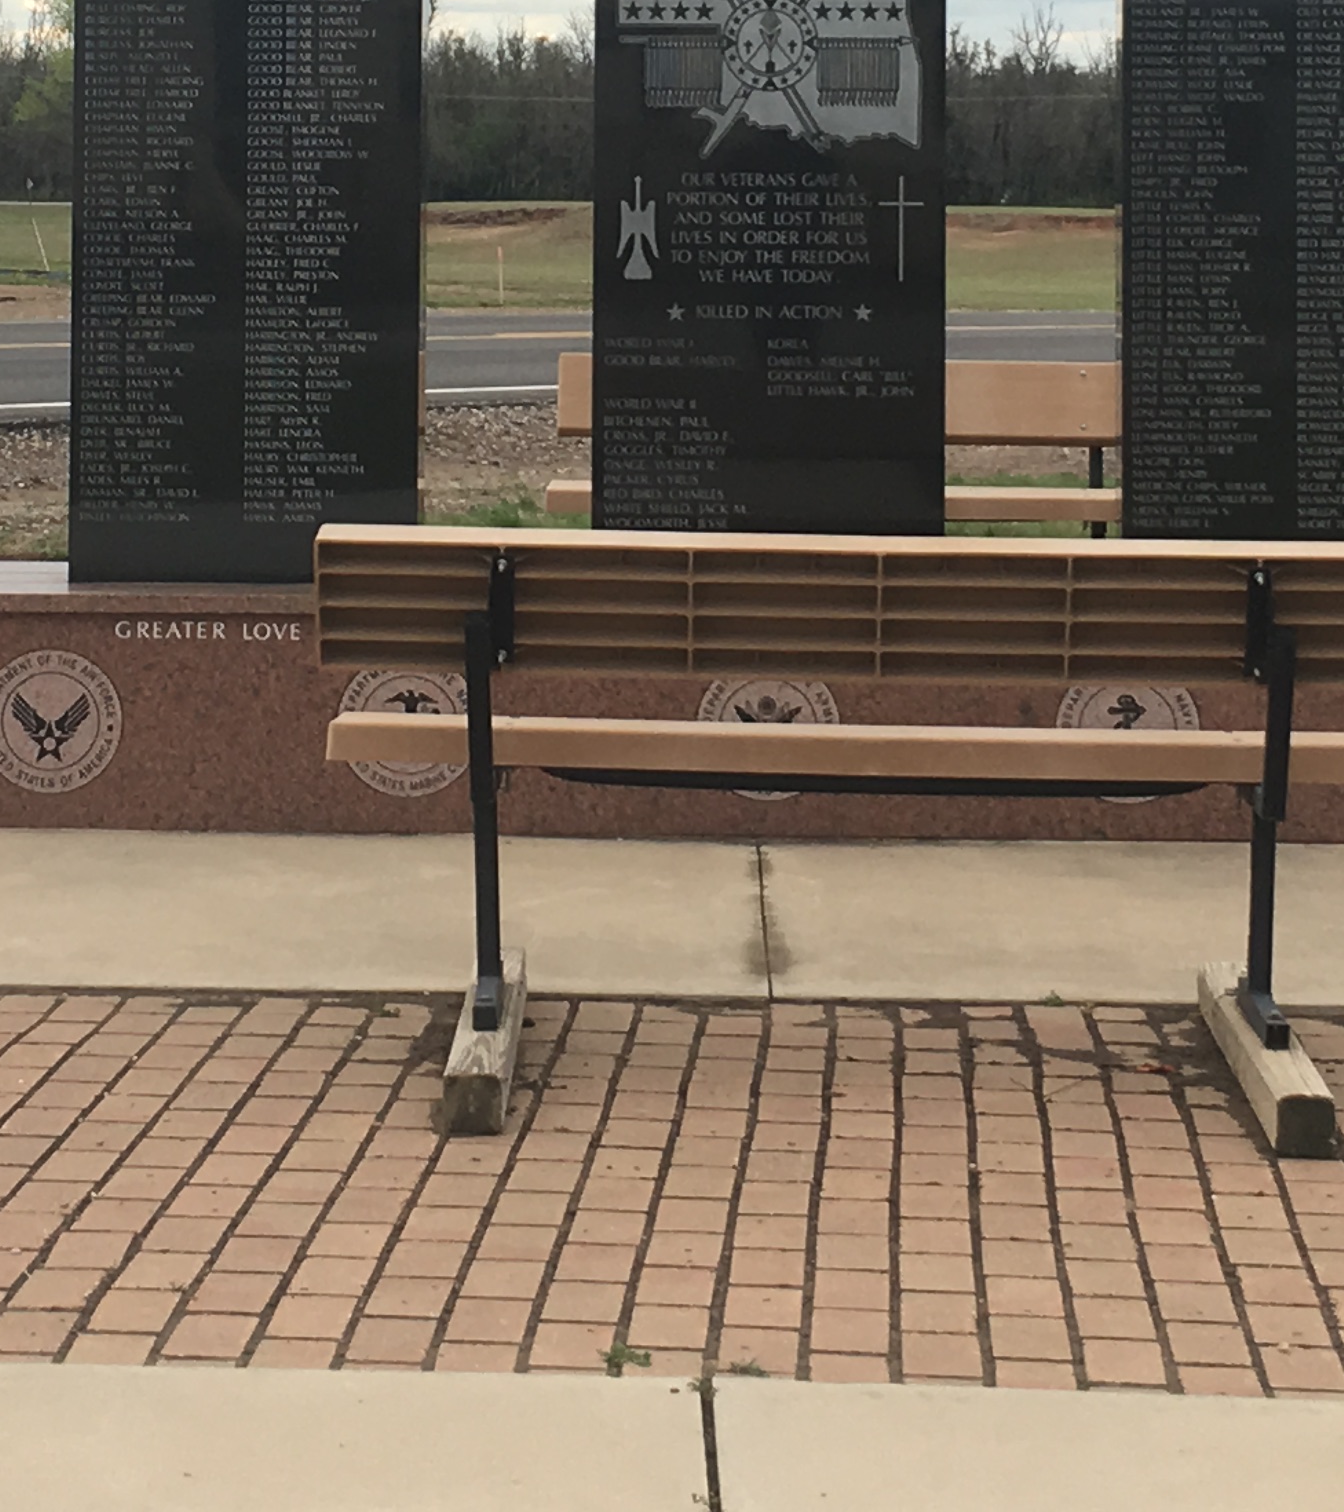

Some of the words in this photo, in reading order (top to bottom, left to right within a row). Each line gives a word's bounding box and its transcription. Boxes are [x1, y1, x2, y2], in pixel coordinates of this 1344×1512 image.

[681, 172, 716, 187] OUR
[720, 172, 796, 187] VETERANS
[801, 172, 839, 187] GAVE
[847, 172, 858, 187] A
[666, 192, 739, 206] PORTION
[745, 192, 766, 206] OF
[774, 192, 819, 206] THEIR
[673, 212, 713, 226] AND
[719, 212, 766, 226] SOME
[774, 212, 812, 226] LOST
[819, 212, 864, 226] THEIR
[671, 230, 712, 245] LIVES
[720, 230, 737, 245] IN
[743, 230, 800, 245] ORDER
[806, 230, 839, 245] FOR
[846, 230, 868, 245] US
[670, 250, 692, 264] TO
[698, 250, 748, 264] ENJOY
[756, 250, 784, 264] THE
[791, 250, 870, 264] FREEDOM
[699, 269, 725, 283] WE
[732, 269, 773, 283] HAVE
[696, 305, 748, 320] KILLED
[756, 305, 772, 320] IN
[778, 305, 842, 320] ACTION
[768, 339, 809, 349] KOREA
[114, 620, 226, 640] GREATER
[242, 622, 301, 641] LOVE
[37, 654, 50, 666] OF
[56, 654, 78, 670] THE
[80, 664, 97, 682] AIR
[96, 680, 117, 718] FORCE
[15, 768, 55, 788] STATES
[60, 775, 74, 788] OF
[78, 738, 113, 780] AMERICA
[370, 773, 406, 791] STATES
[409, 770, 448, 791] MARINE
